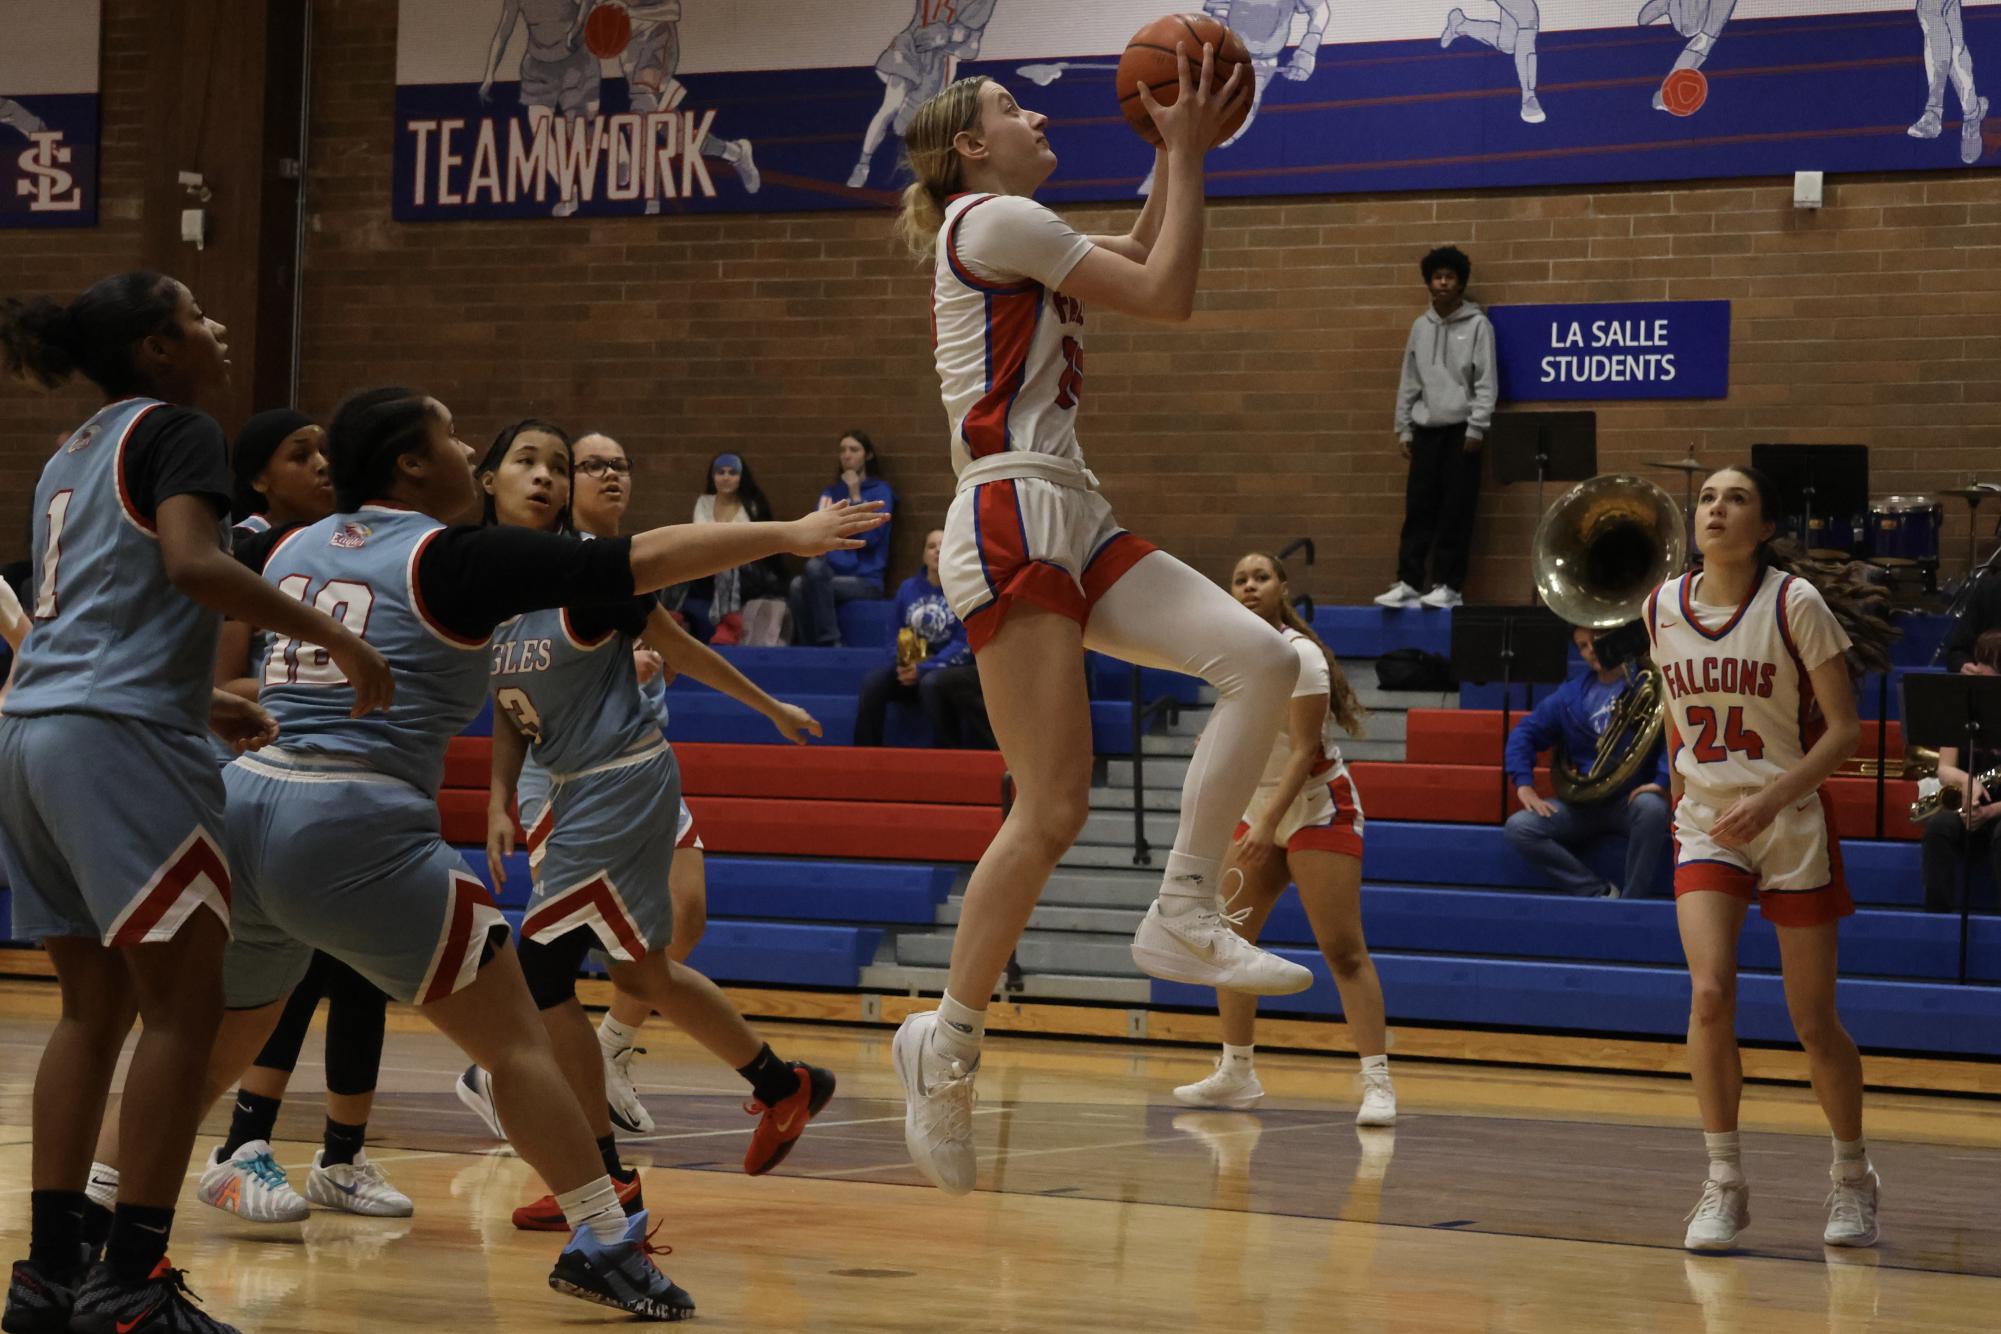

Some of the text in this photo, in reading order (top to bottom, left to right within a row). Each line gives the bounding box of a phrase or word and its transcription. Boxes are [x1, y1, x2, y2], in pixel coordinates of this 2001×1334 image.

[406, 108, 718, 206] TEAMWORK
[1551, 319, 1669, 348] LA SALLE
[1540, 353, 1677, 383] STUDENTS
[35, 487, 74, 620] 1
[1661, 656, 1777, 701] FALCONS
[1685, 704, 1766, 764] 24
